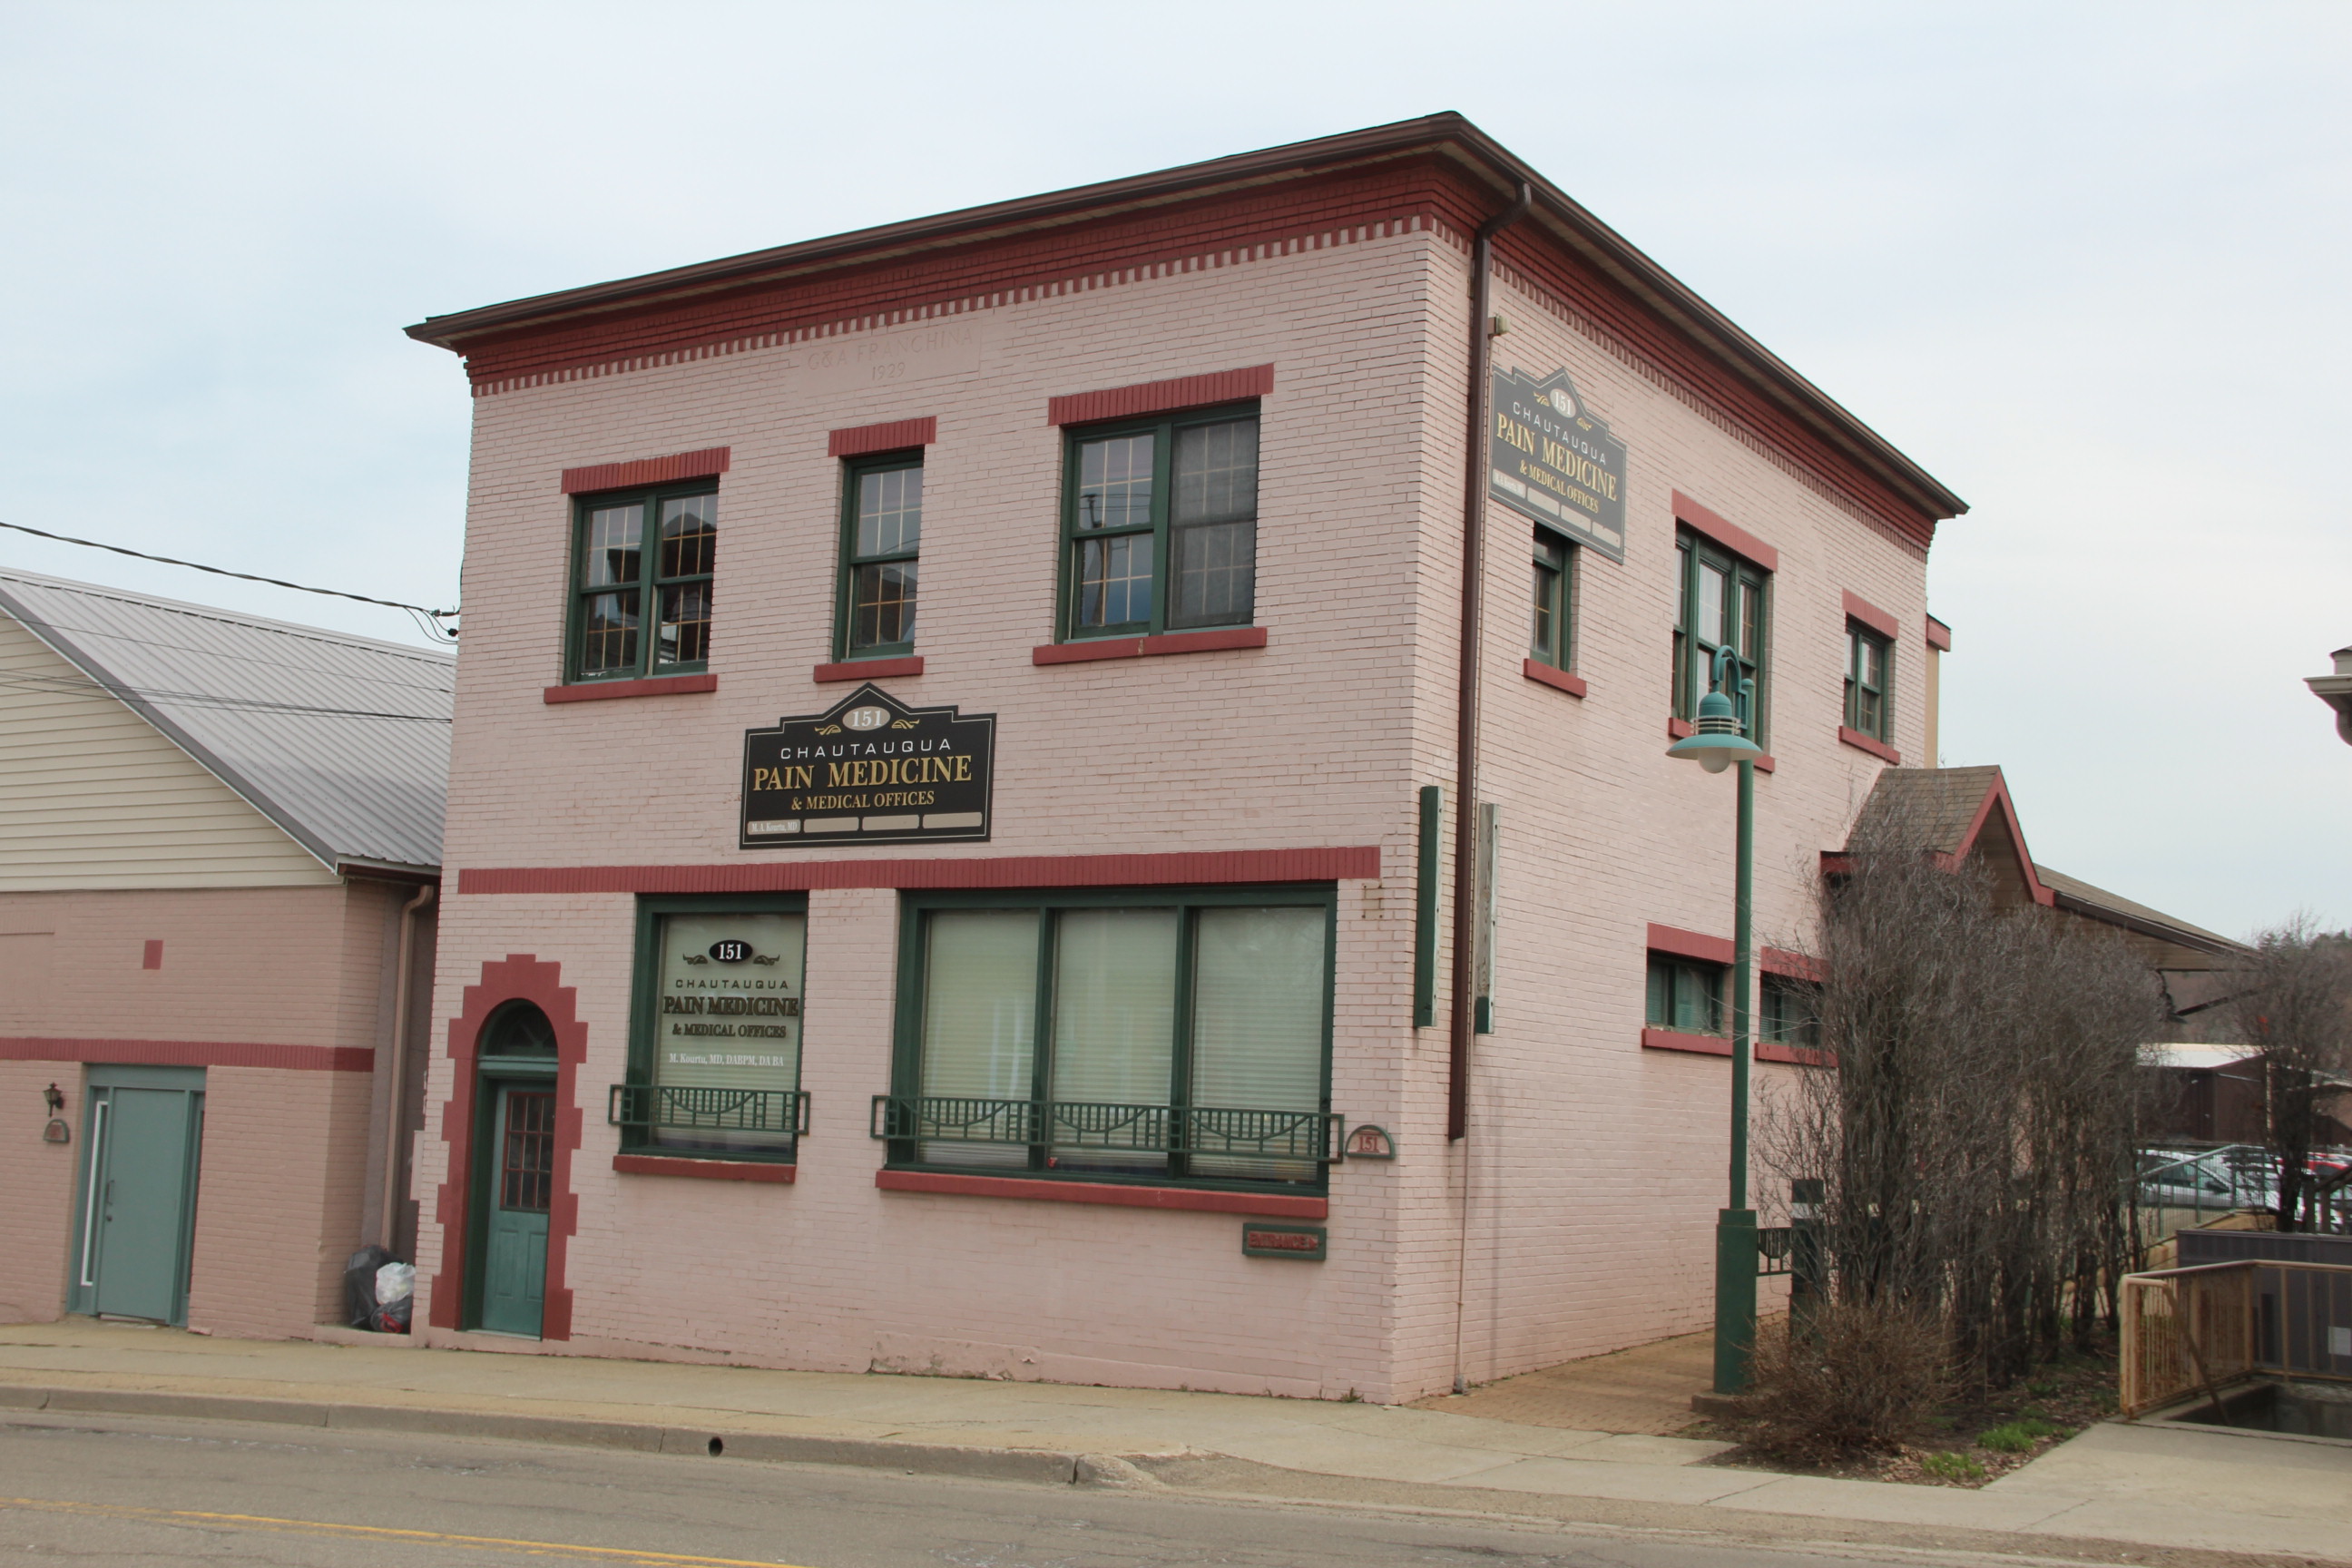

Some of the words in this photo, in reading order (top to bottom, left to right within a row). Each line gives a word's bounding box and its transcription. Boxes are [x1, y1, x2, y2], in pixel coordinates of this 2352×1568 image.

[857, 328, 974, 363] FRANCHINA
[872, 362, 906, 381] 1929
[1554, 390, 1572, 416] 151
[1513, 401, 1607, 466] CHAUTAUQUA
[1496, 412, 1535, 456] PAIN
[1541, 436, 1618, 502] MEDICINE
[1519, 459, 1528, 475] &
[1528, 466, 1567, 496] MEDICAL
[1567, 485, 1600, 514] OFFICES
[851, 710, 883, 728] 151
[780, 738, 951, 760] CHAUTAUQUA
[753, 765, 814, 791] PAIN
[828, 755, 973, 788] MEDICINE
[791, 797, 802, 810] &
[806, 794, 870, 809] MEDICAL
[874, 790, 935, 807] OFFICES
[788, 821, 798, 831] MD
[719, 943, 742, 960] 151
[675, 979, 789, 989] CHAUTAUQUA
[663, 995, 705, 1014] PAIN
[707, 996, 799, 1016] MEDICINE
[672, 1024, 681, 1035] &
[683, 1024, 736, 1037] MEDICAL
[738, 1024, 787, 1038] OFFICES
[669, 1054, 679, 1063] M.
[710, 1054, 724, 1065] MD,
[726, 1055, 758, 1066] DABPM,
[1358, 1135, 1378, 1152] 151
[1249, 1232, 1307, 1249] ENTRANCE
